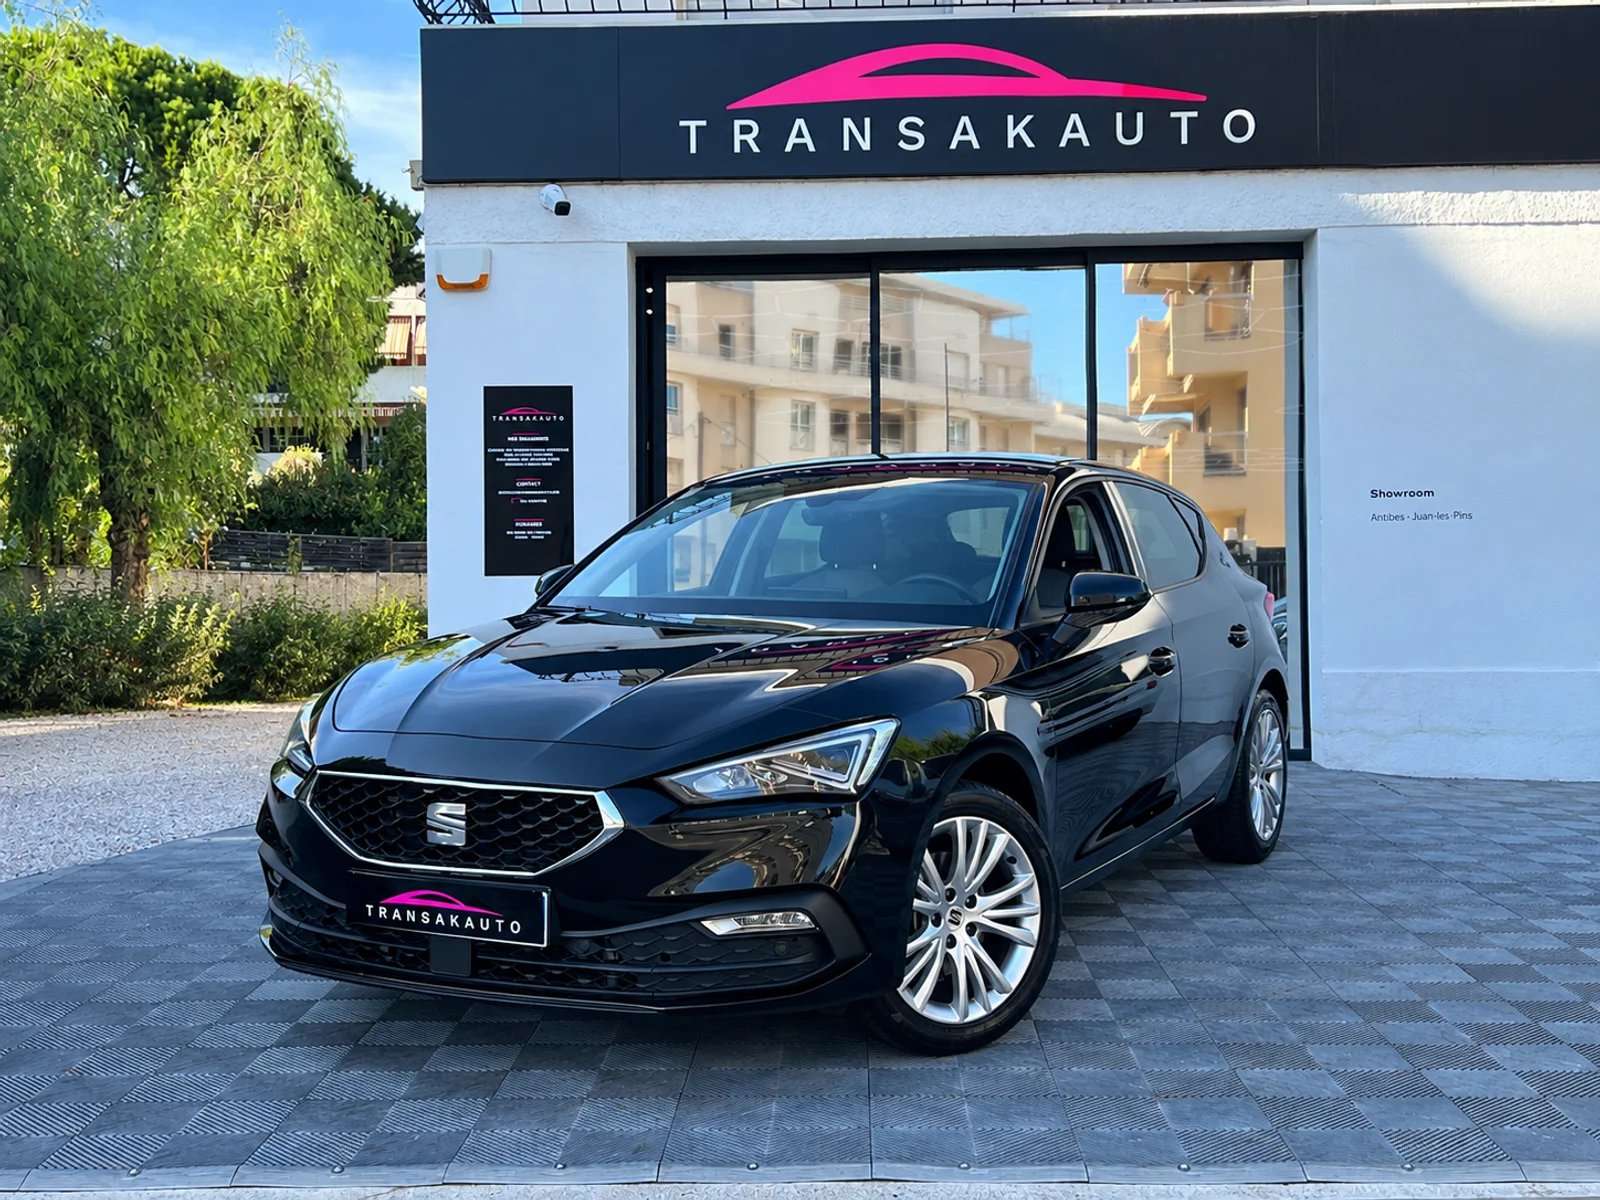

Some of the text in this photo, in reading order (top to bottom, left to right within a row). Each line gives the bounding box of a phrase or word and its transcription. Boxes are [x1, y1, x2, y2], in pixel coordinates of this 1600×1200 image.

[679, 108, 1257, 154] TRANSAKAUTO
[1370, 489, 1435, 499] Showroom
[1370, 512, 1405, 521] Antibes
[365, 904, 521, 934] TRANSAKAUTO
